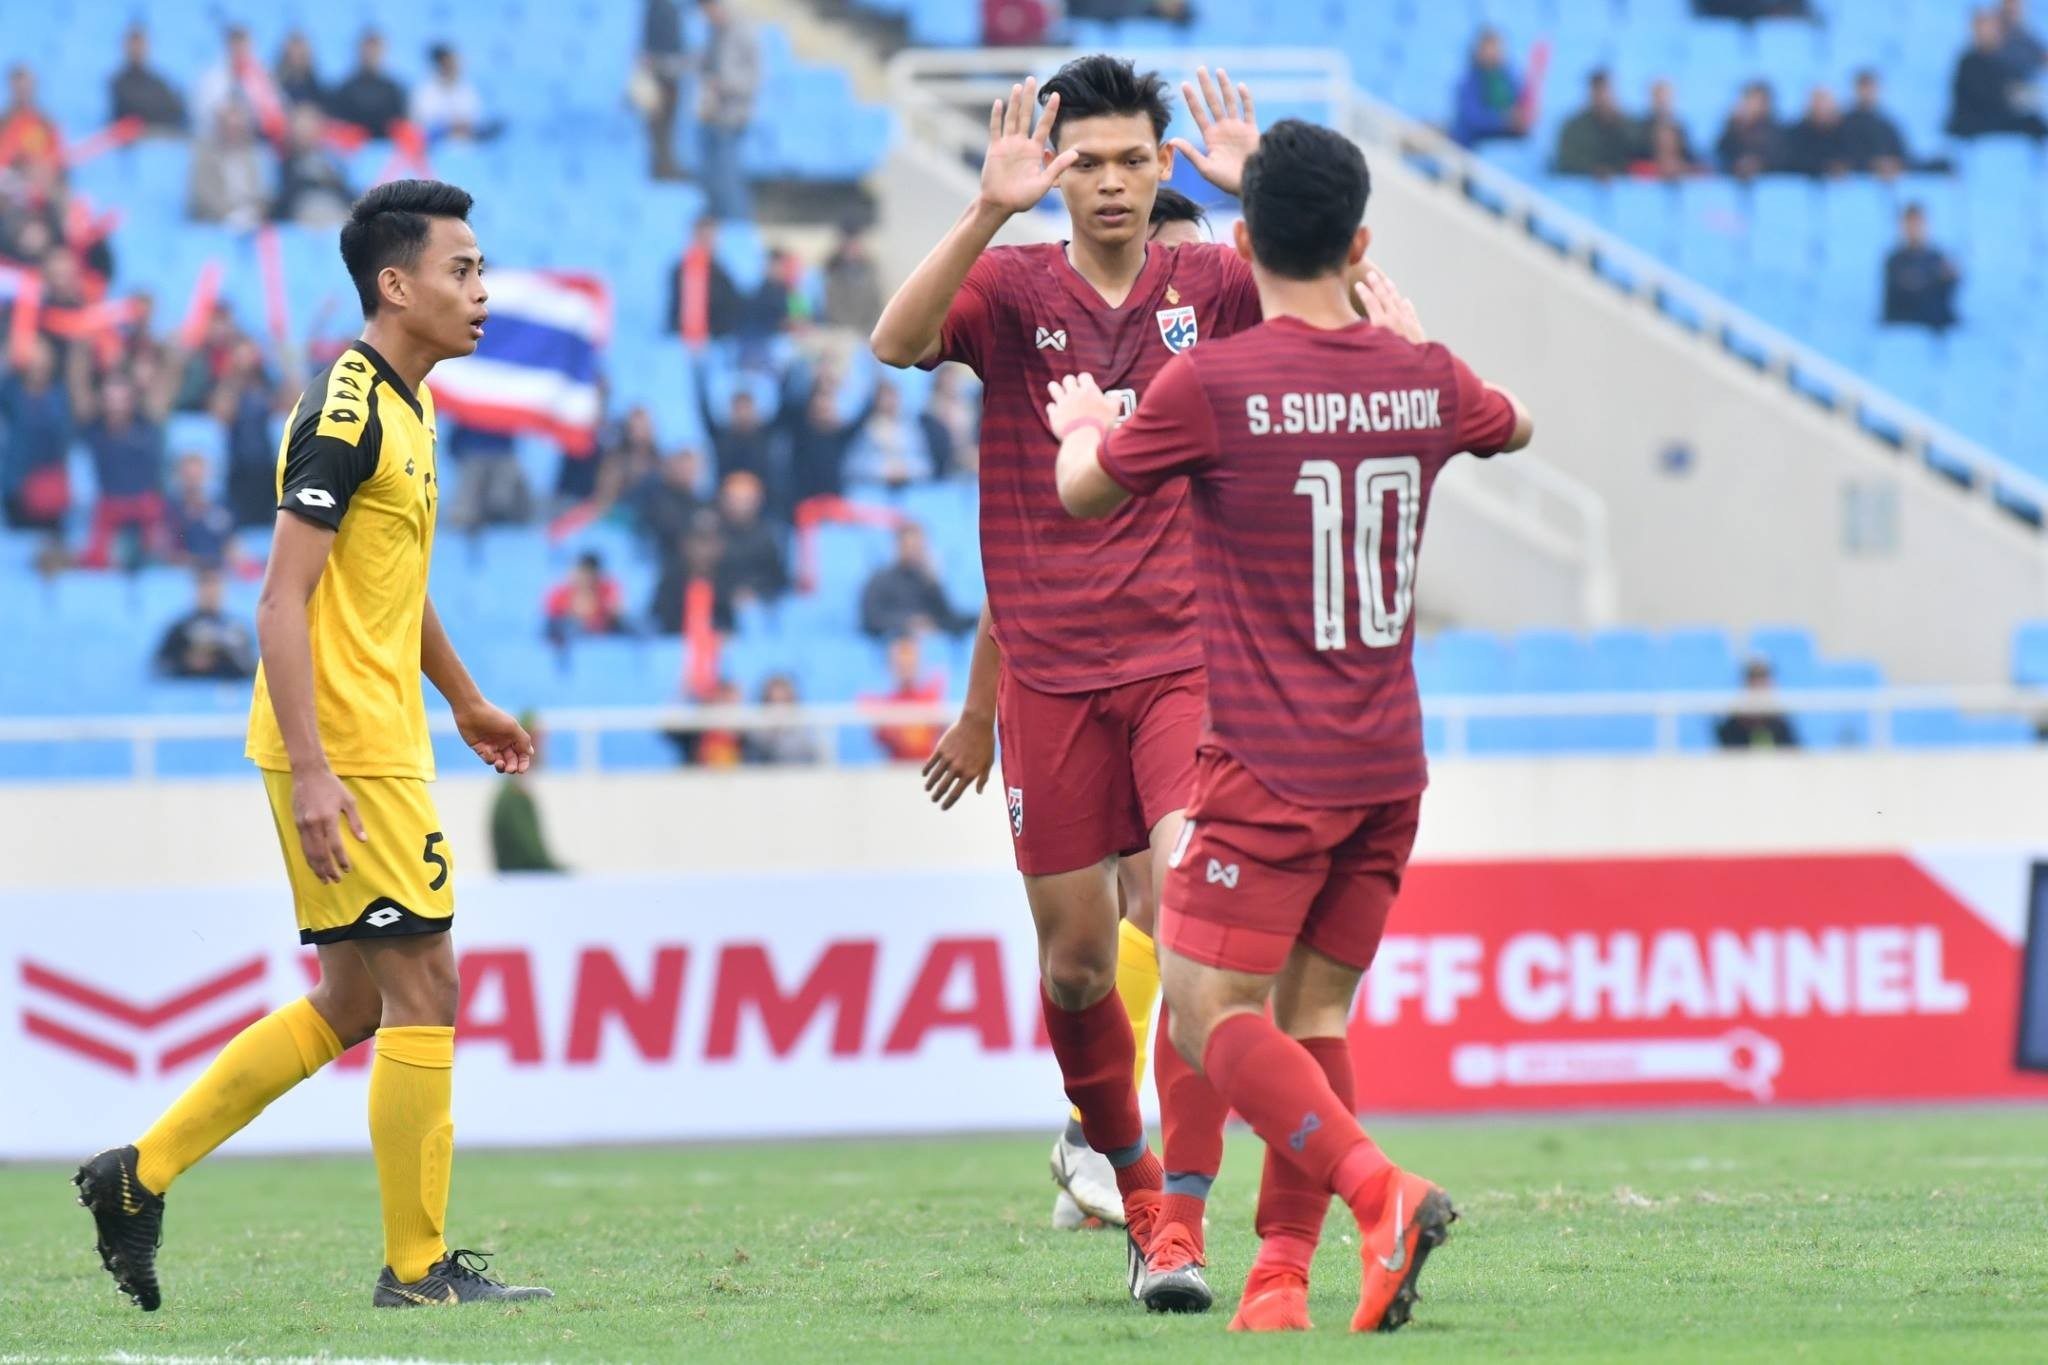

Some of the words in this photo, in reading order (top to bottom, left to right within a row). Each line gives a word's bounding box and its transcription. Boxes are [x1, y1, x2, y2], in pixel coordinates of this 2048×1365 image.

[1246, 388, 1442, 434] S.SUPACHOK
[1293, 455, 1421, 650] 10
[423, 831, 447, 891] 5
[295, 937, 1051, 1067] ANMA
[1349, 935, 1483, 1025] FF
[1496, 925, 1970, 1024] CHANNEL
